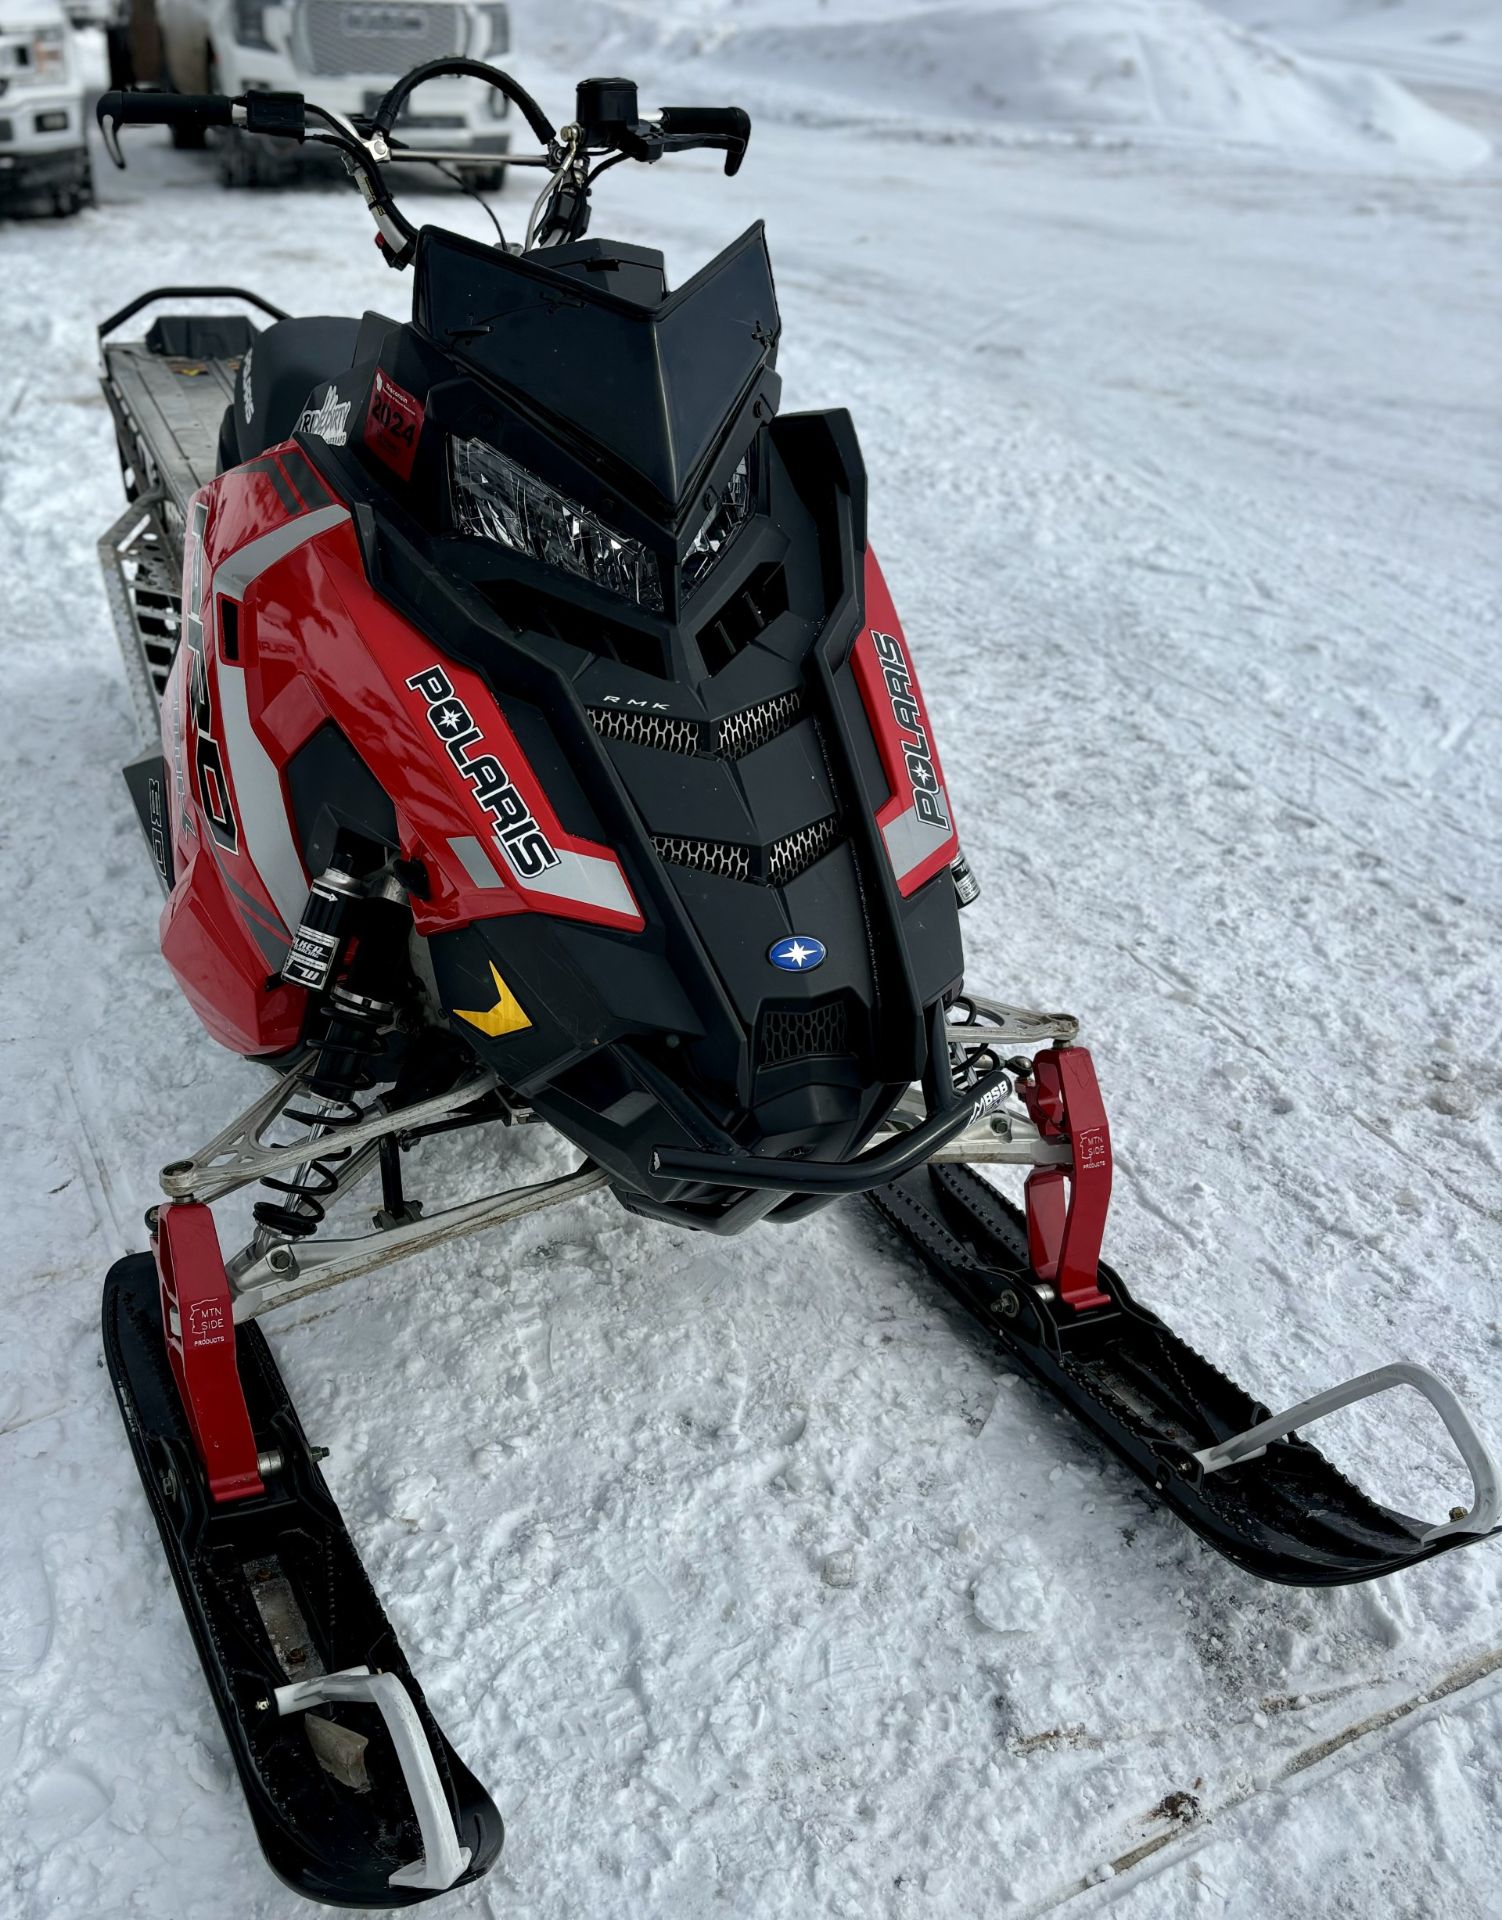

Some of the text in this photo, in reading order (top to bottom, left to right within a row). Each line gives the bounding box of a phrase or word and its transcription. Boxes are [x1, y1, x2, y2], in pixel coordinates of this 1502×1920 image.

[371, 393, 416, 449] 2024
[602, 694, 671, 711] RMK
[870, 628, 952, 832] POLARIS
[404, 663, 562, 879] POLARIS
[982, 1080, 1009, 1107] BSB
[1086, 1135, 1104, 1146] MTN
[1087, 1145, 1105, 1156] SIDE
[1082, 1160, 1106, 1170] PRODUCTS
[201, 1307, 222, 1318] MTN
[201, 1318, 225, 1331] SIDE
[194, 1335, 225, 1346] PRODUCTS
